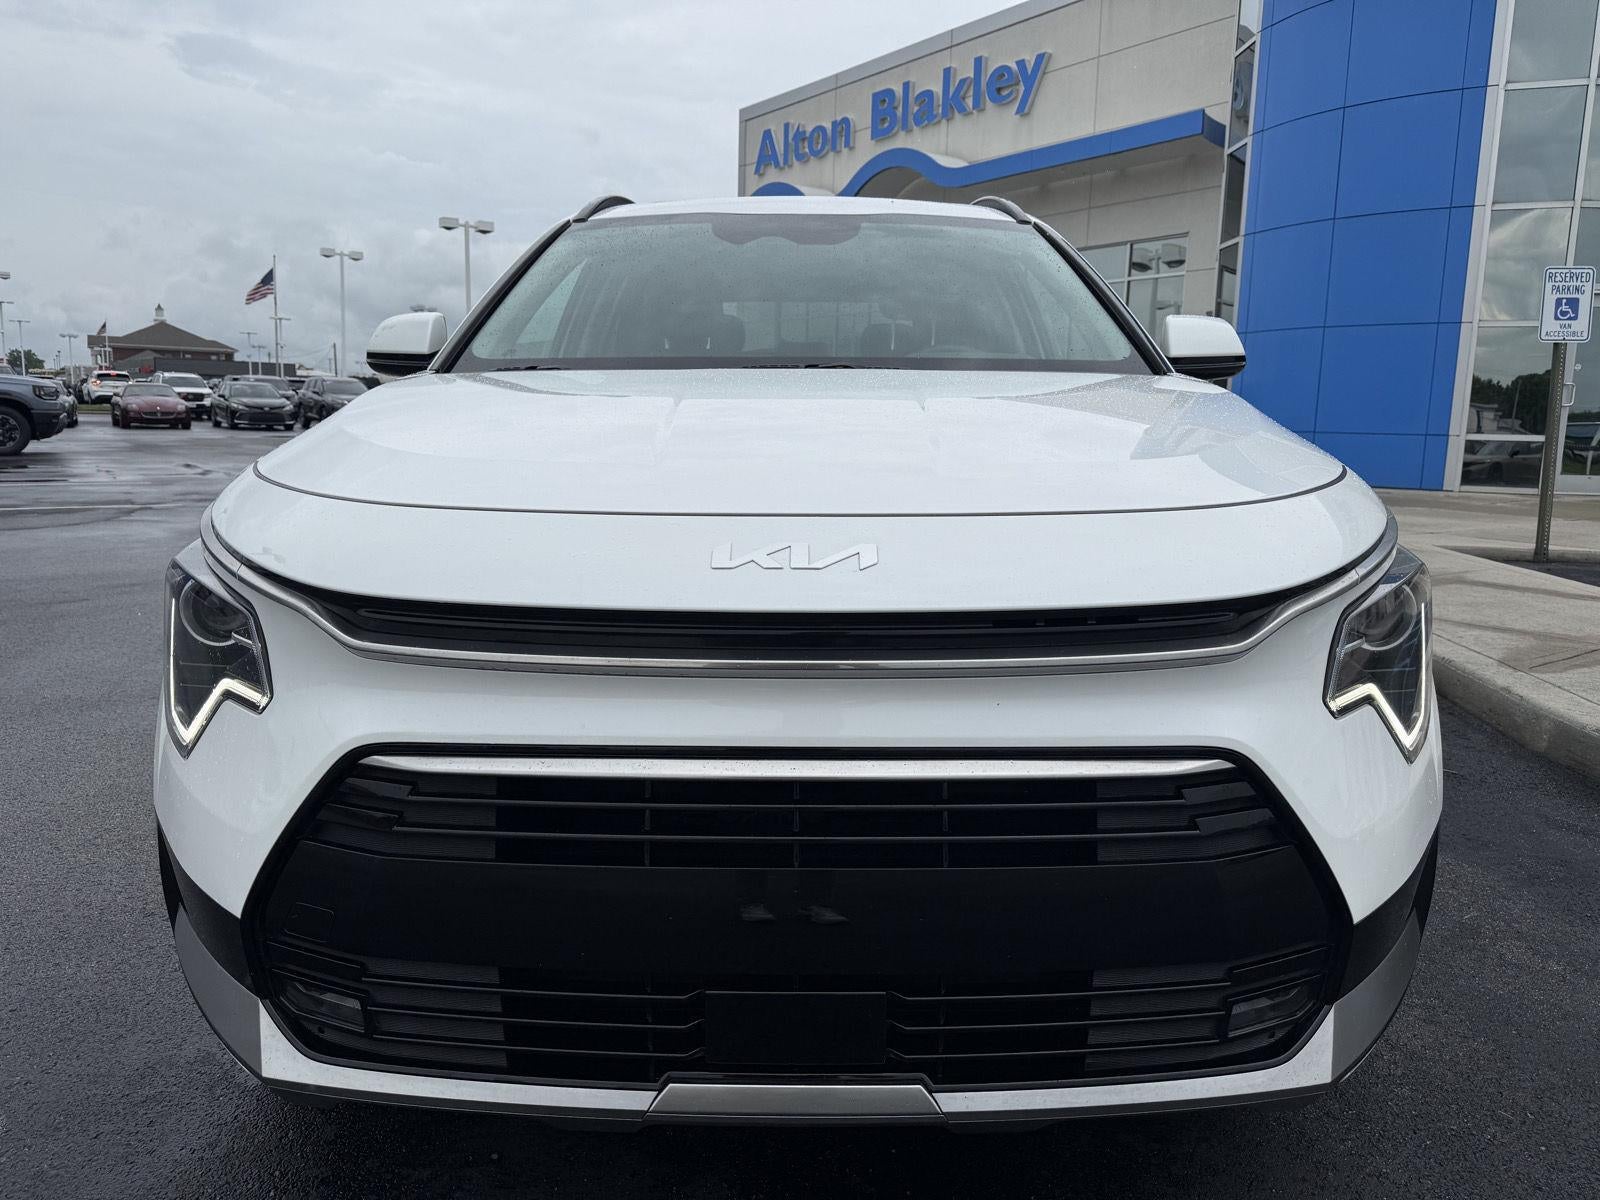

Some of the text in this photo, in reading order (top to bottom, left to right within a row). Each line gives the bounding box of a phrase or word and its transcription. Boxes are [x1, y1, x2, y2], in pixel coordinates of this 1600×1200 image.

[754, 51, 1051, 176] Alton Blakley
[1548, 271, 1591, 283] RESERVED
[1551, 284, 1586, 295] PARKING
[1545, 330, 1584, 338] ACCESSIBLE
[711, 543, 878, 571] KIA
